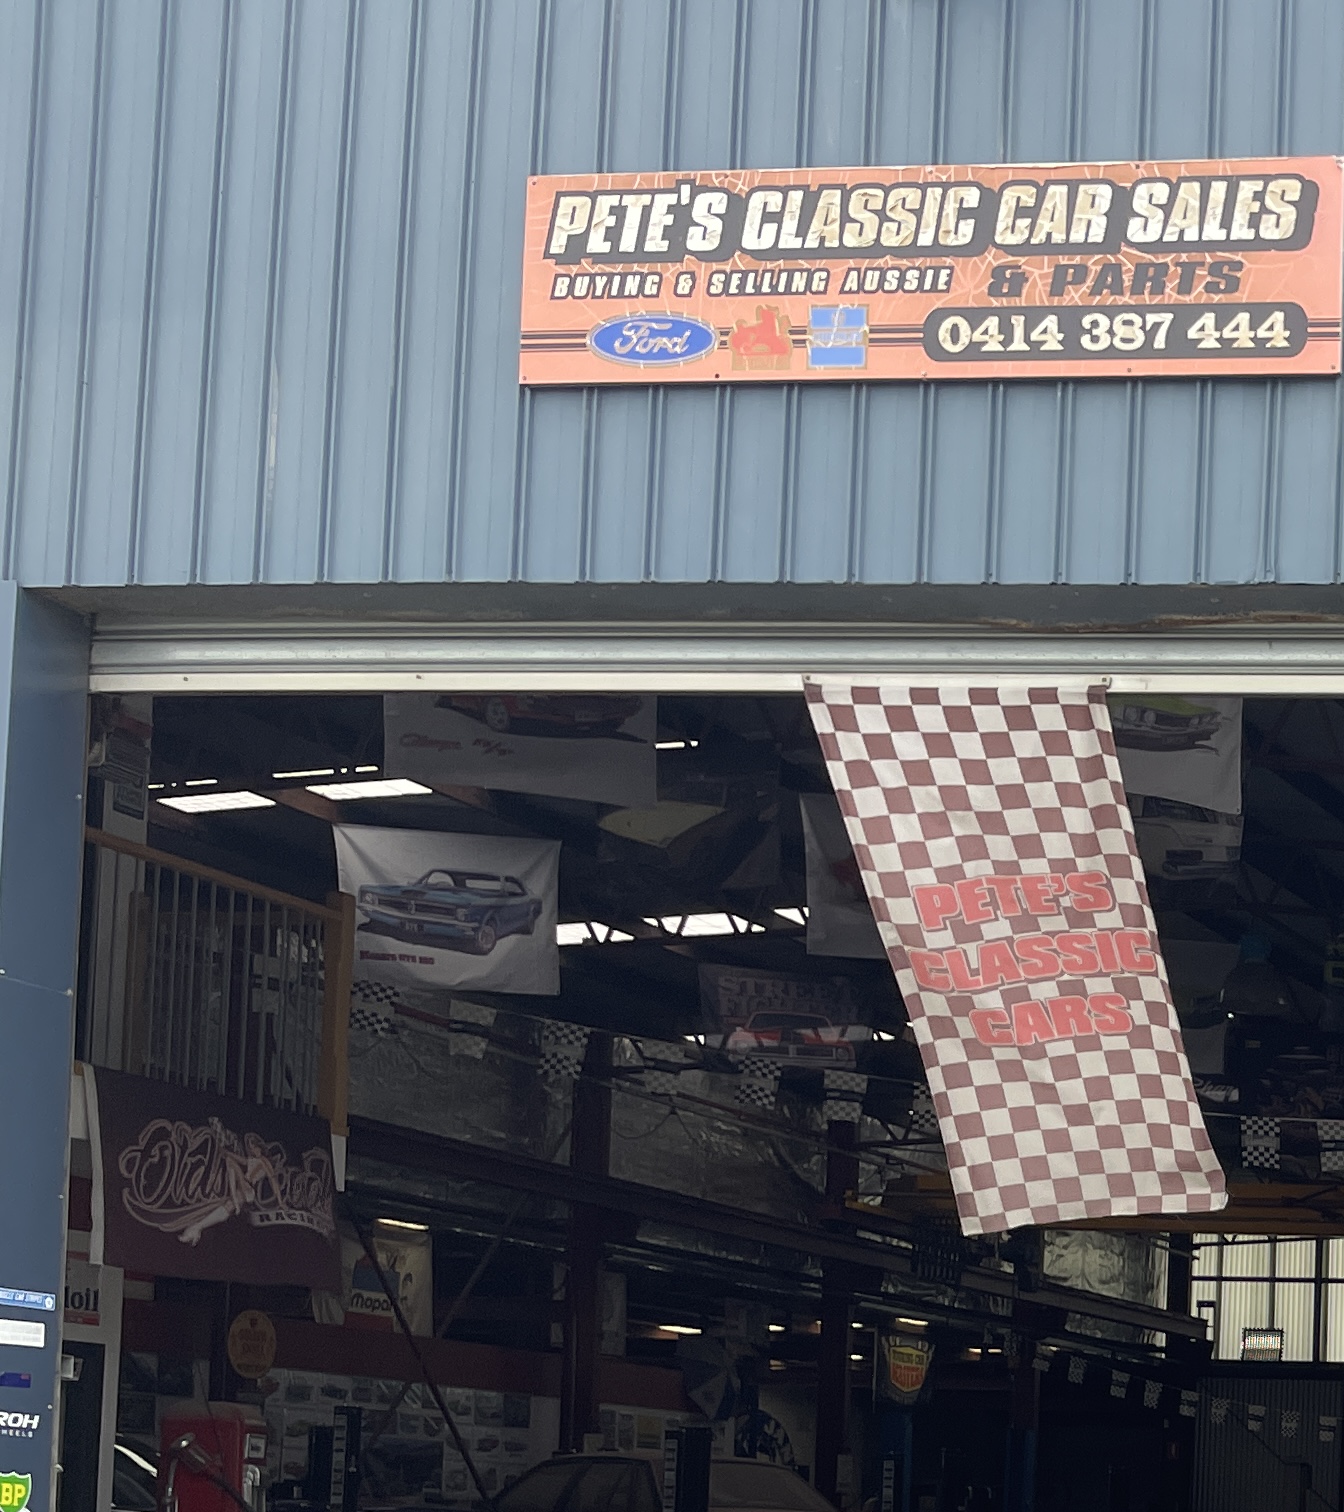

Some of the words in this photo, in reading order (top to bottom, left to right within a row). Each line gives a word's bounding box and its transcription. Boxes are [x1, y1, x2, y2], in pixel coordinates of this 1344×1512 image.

[548, 184, 729, 254] PETE'S
[741, 184, 981, 251] CLASSIC
[994, 183, 1113, 245] CAR
[1126, 178, 1302, 244] SALES
[554, 274, 660, 297] BUYING
[676, 276, 694, 295] &
[709, 271, 828, 295] SELLING
[844, 269, 952, 293] AUSSIE
[988, 265, 1029, 297] &
[1050, 260, 1244, 297] PARTS
[614, 321, 691, 354] Ford
[938, 315, 1064, 353] 0414
[1081, 312, 1174, 351] 387
[1187, 311, 1291, 349] 444
[912, 870, 1115, 932] PETE'S
[909, 930, 1158, 992] CLASSIC
[969, 993, 1134, 1048] CARS
[1, 1483, 26, 1506] BP
